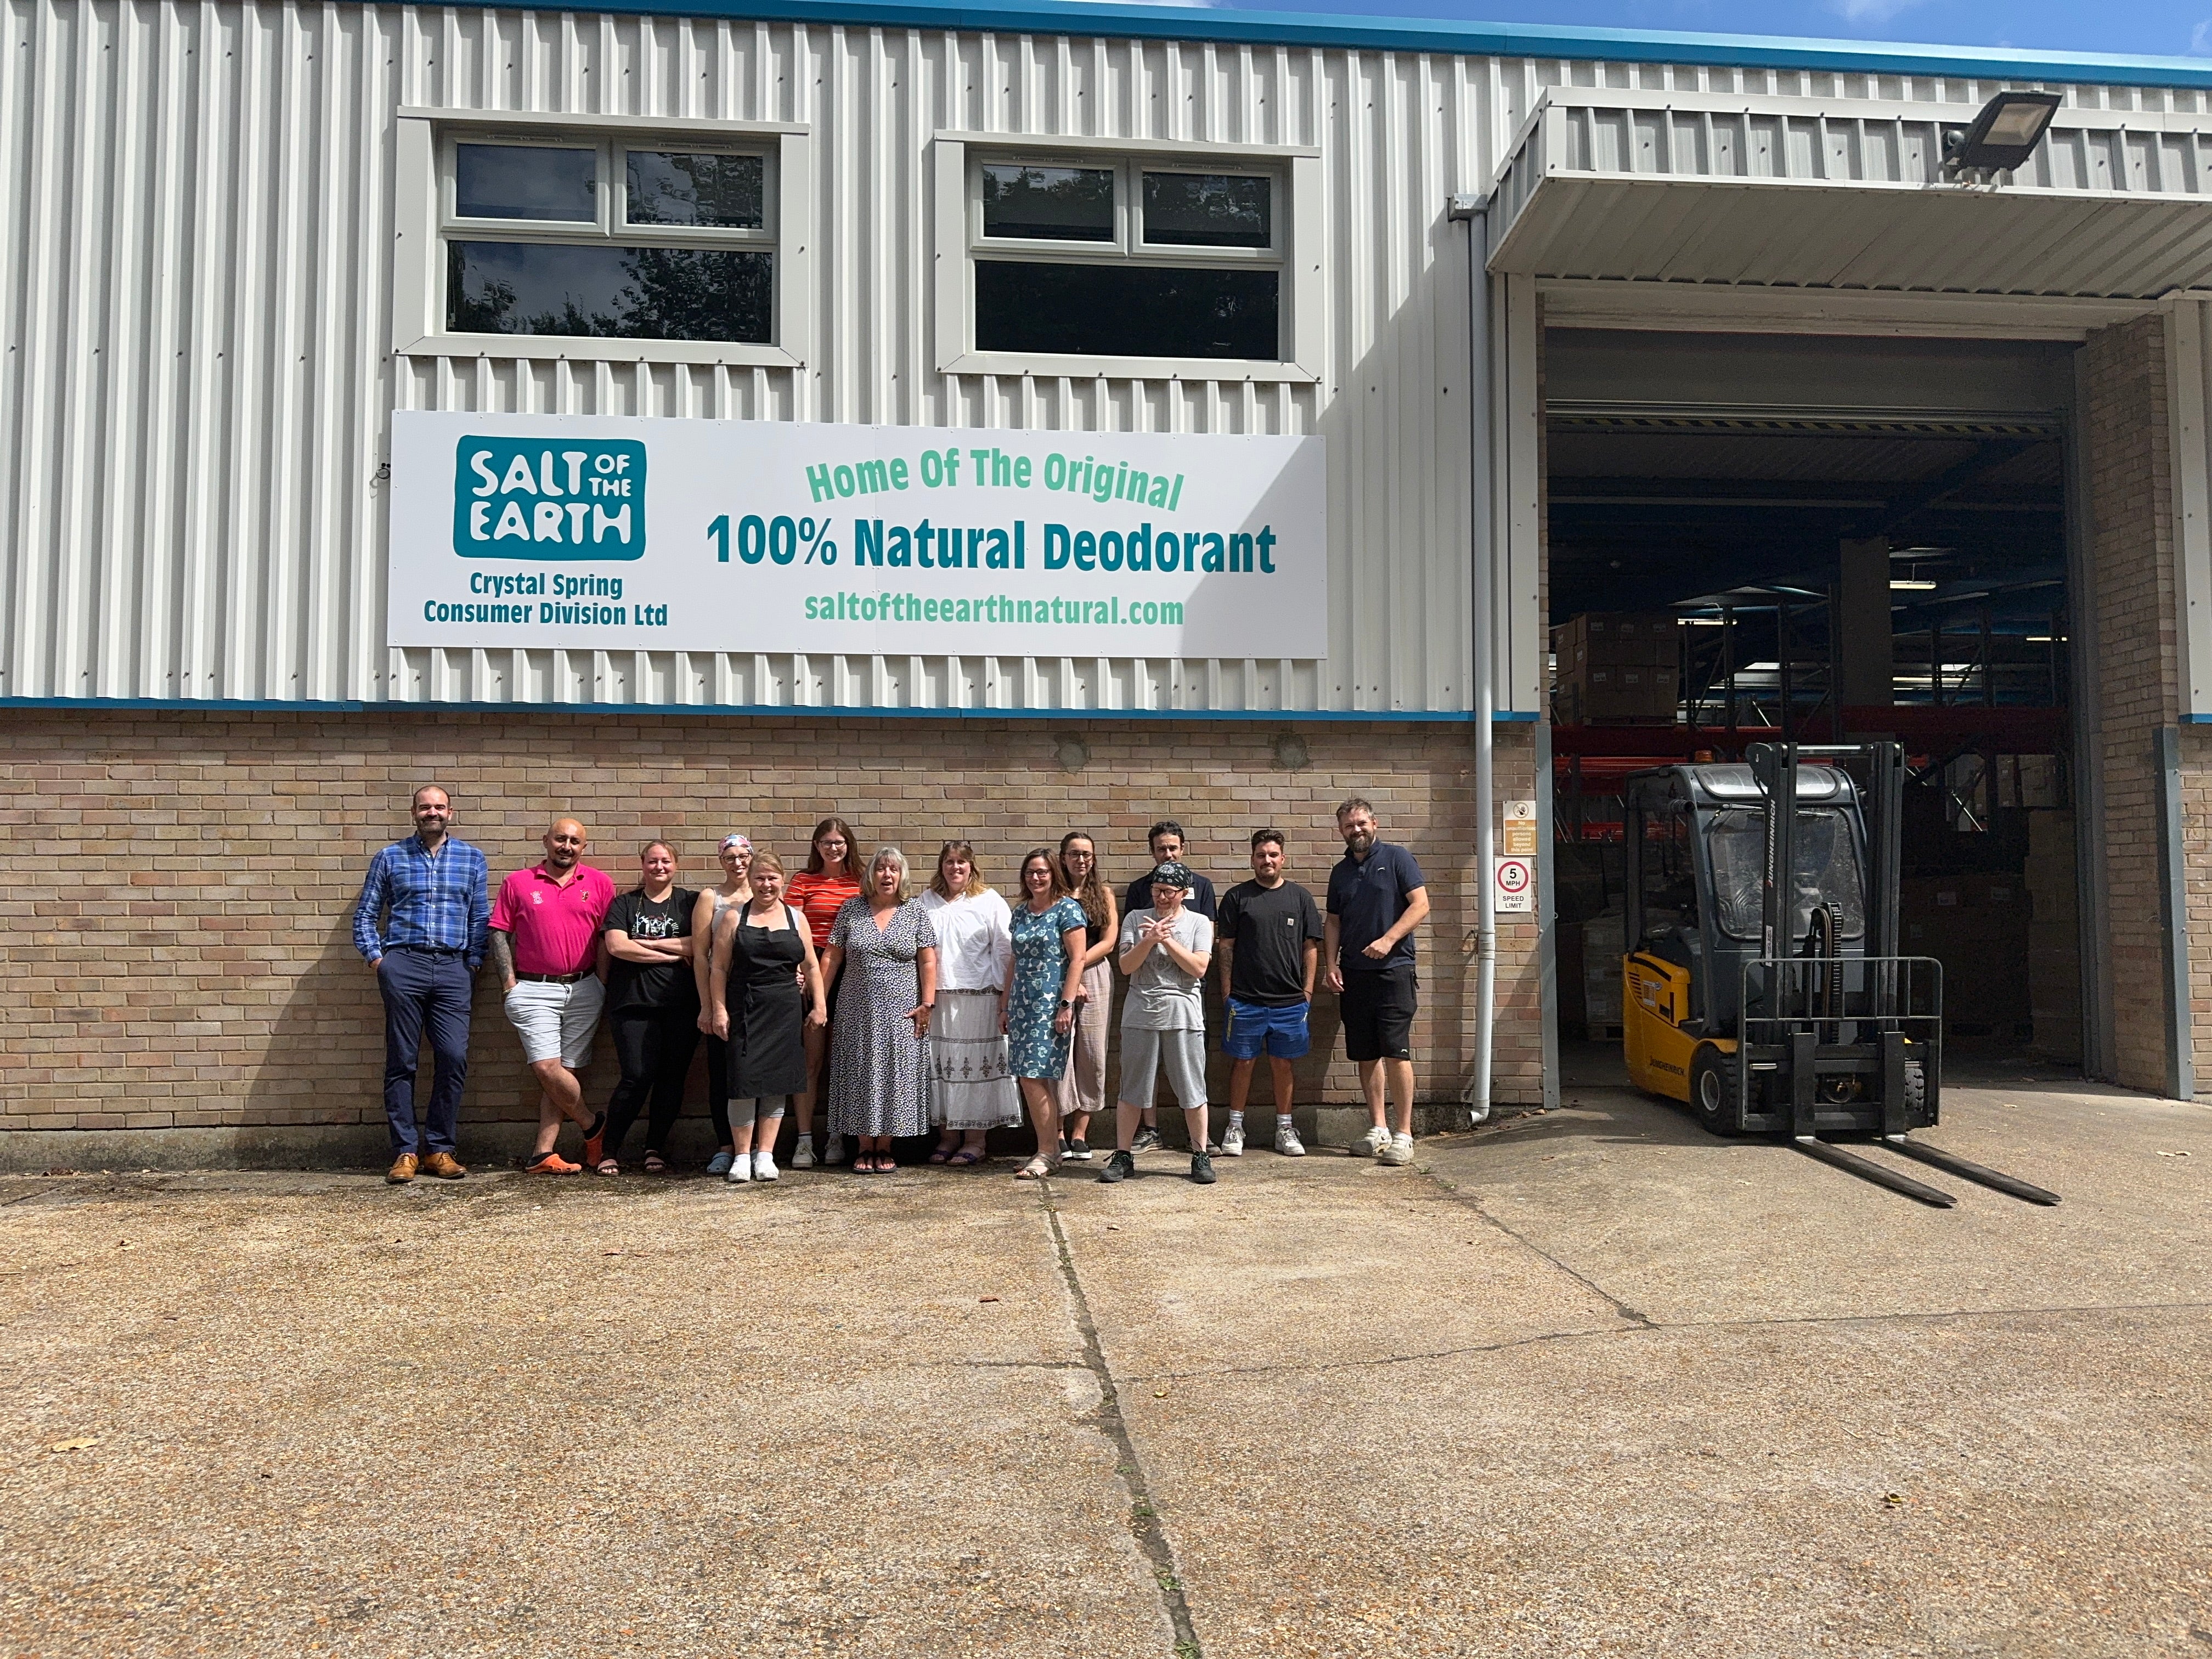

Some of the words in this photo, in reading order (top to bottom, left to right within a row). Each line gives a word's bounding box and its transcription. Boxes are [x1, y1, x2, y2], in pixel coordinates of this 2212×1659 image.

[470, 450, 588, 498] SALT
[595, 454, 630, 475] OF
[806, 459, 909, 503] Home
[921, 448, 961, 488] Of
[970, 449, 1032, 488] The
[1044, 453, 1184, 511] Original
[588, 477, 631, 497] THE
[470, 501, 631, 545] EARTH
[707, 514, 837, 566] 100%
[855, 518, 1025, 569] Natural
[1044, 523, 1276, 574] Deodorant
[470, 572, 545, 598] Crystal
[553, 574, 623, 600] Spring
[424, 600, 533, 624] Consumer
[540, 602, 626, 625] Division
[635, 604, 668, 626] Ltd
[805, 592, 1183, 625] saltoftheearthnatural.com
[1510, 868, 1517, 879] 5
